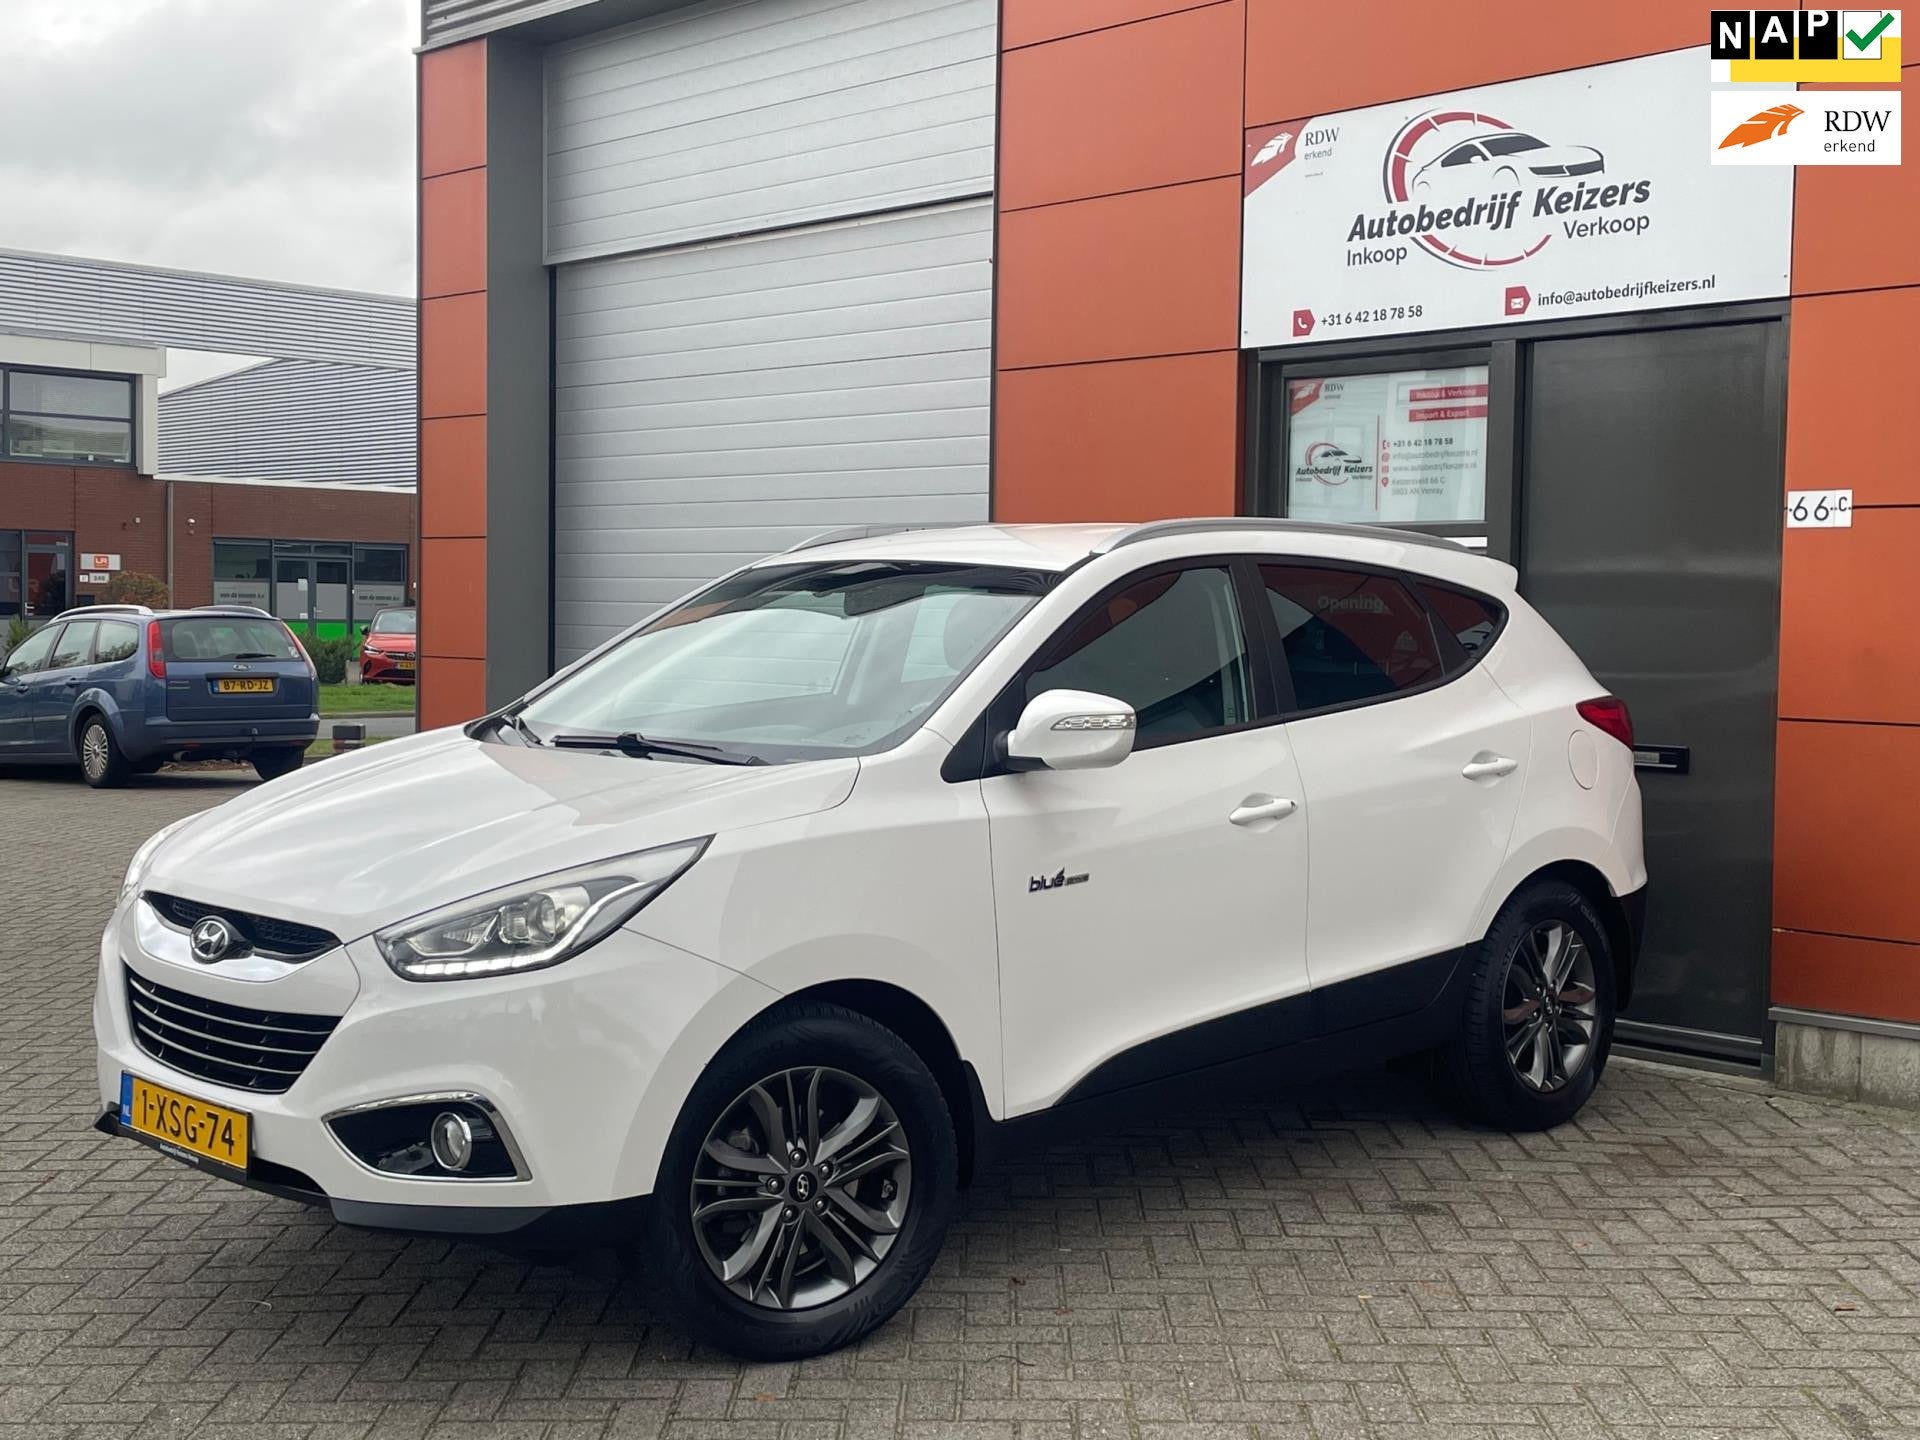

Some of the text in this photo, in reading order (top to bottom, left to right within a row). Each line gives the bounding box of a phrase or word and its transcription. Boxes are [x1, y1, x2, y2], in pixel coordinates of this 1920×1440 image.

[1304, 127, 1340, 147] RDW
[1304, 148, 1332, 160] erkend
[1346, 180, 1651, 242] Autobedrijf Keizers
[1563, 214, 1650, 239] Verkoop
[1346, 246, 1408, 266] Inkoop
[1537, 275, 1716, 306] info@autobedrijfkeizers.nl
[1321, 304, 1423, 326] +31 6 42 18 78 58
[1324, 383, 1344, 392] RDW
[1296, 465, 1373, 476] Autobedrijf Keizers
[1793, 496, 1829, 521] 66
[223, 680, 270, 691] 87-RD-JZ
[1028, 867, 1066, 893] blue
[142, 1089, 235, 1157] 1-XSG-74
